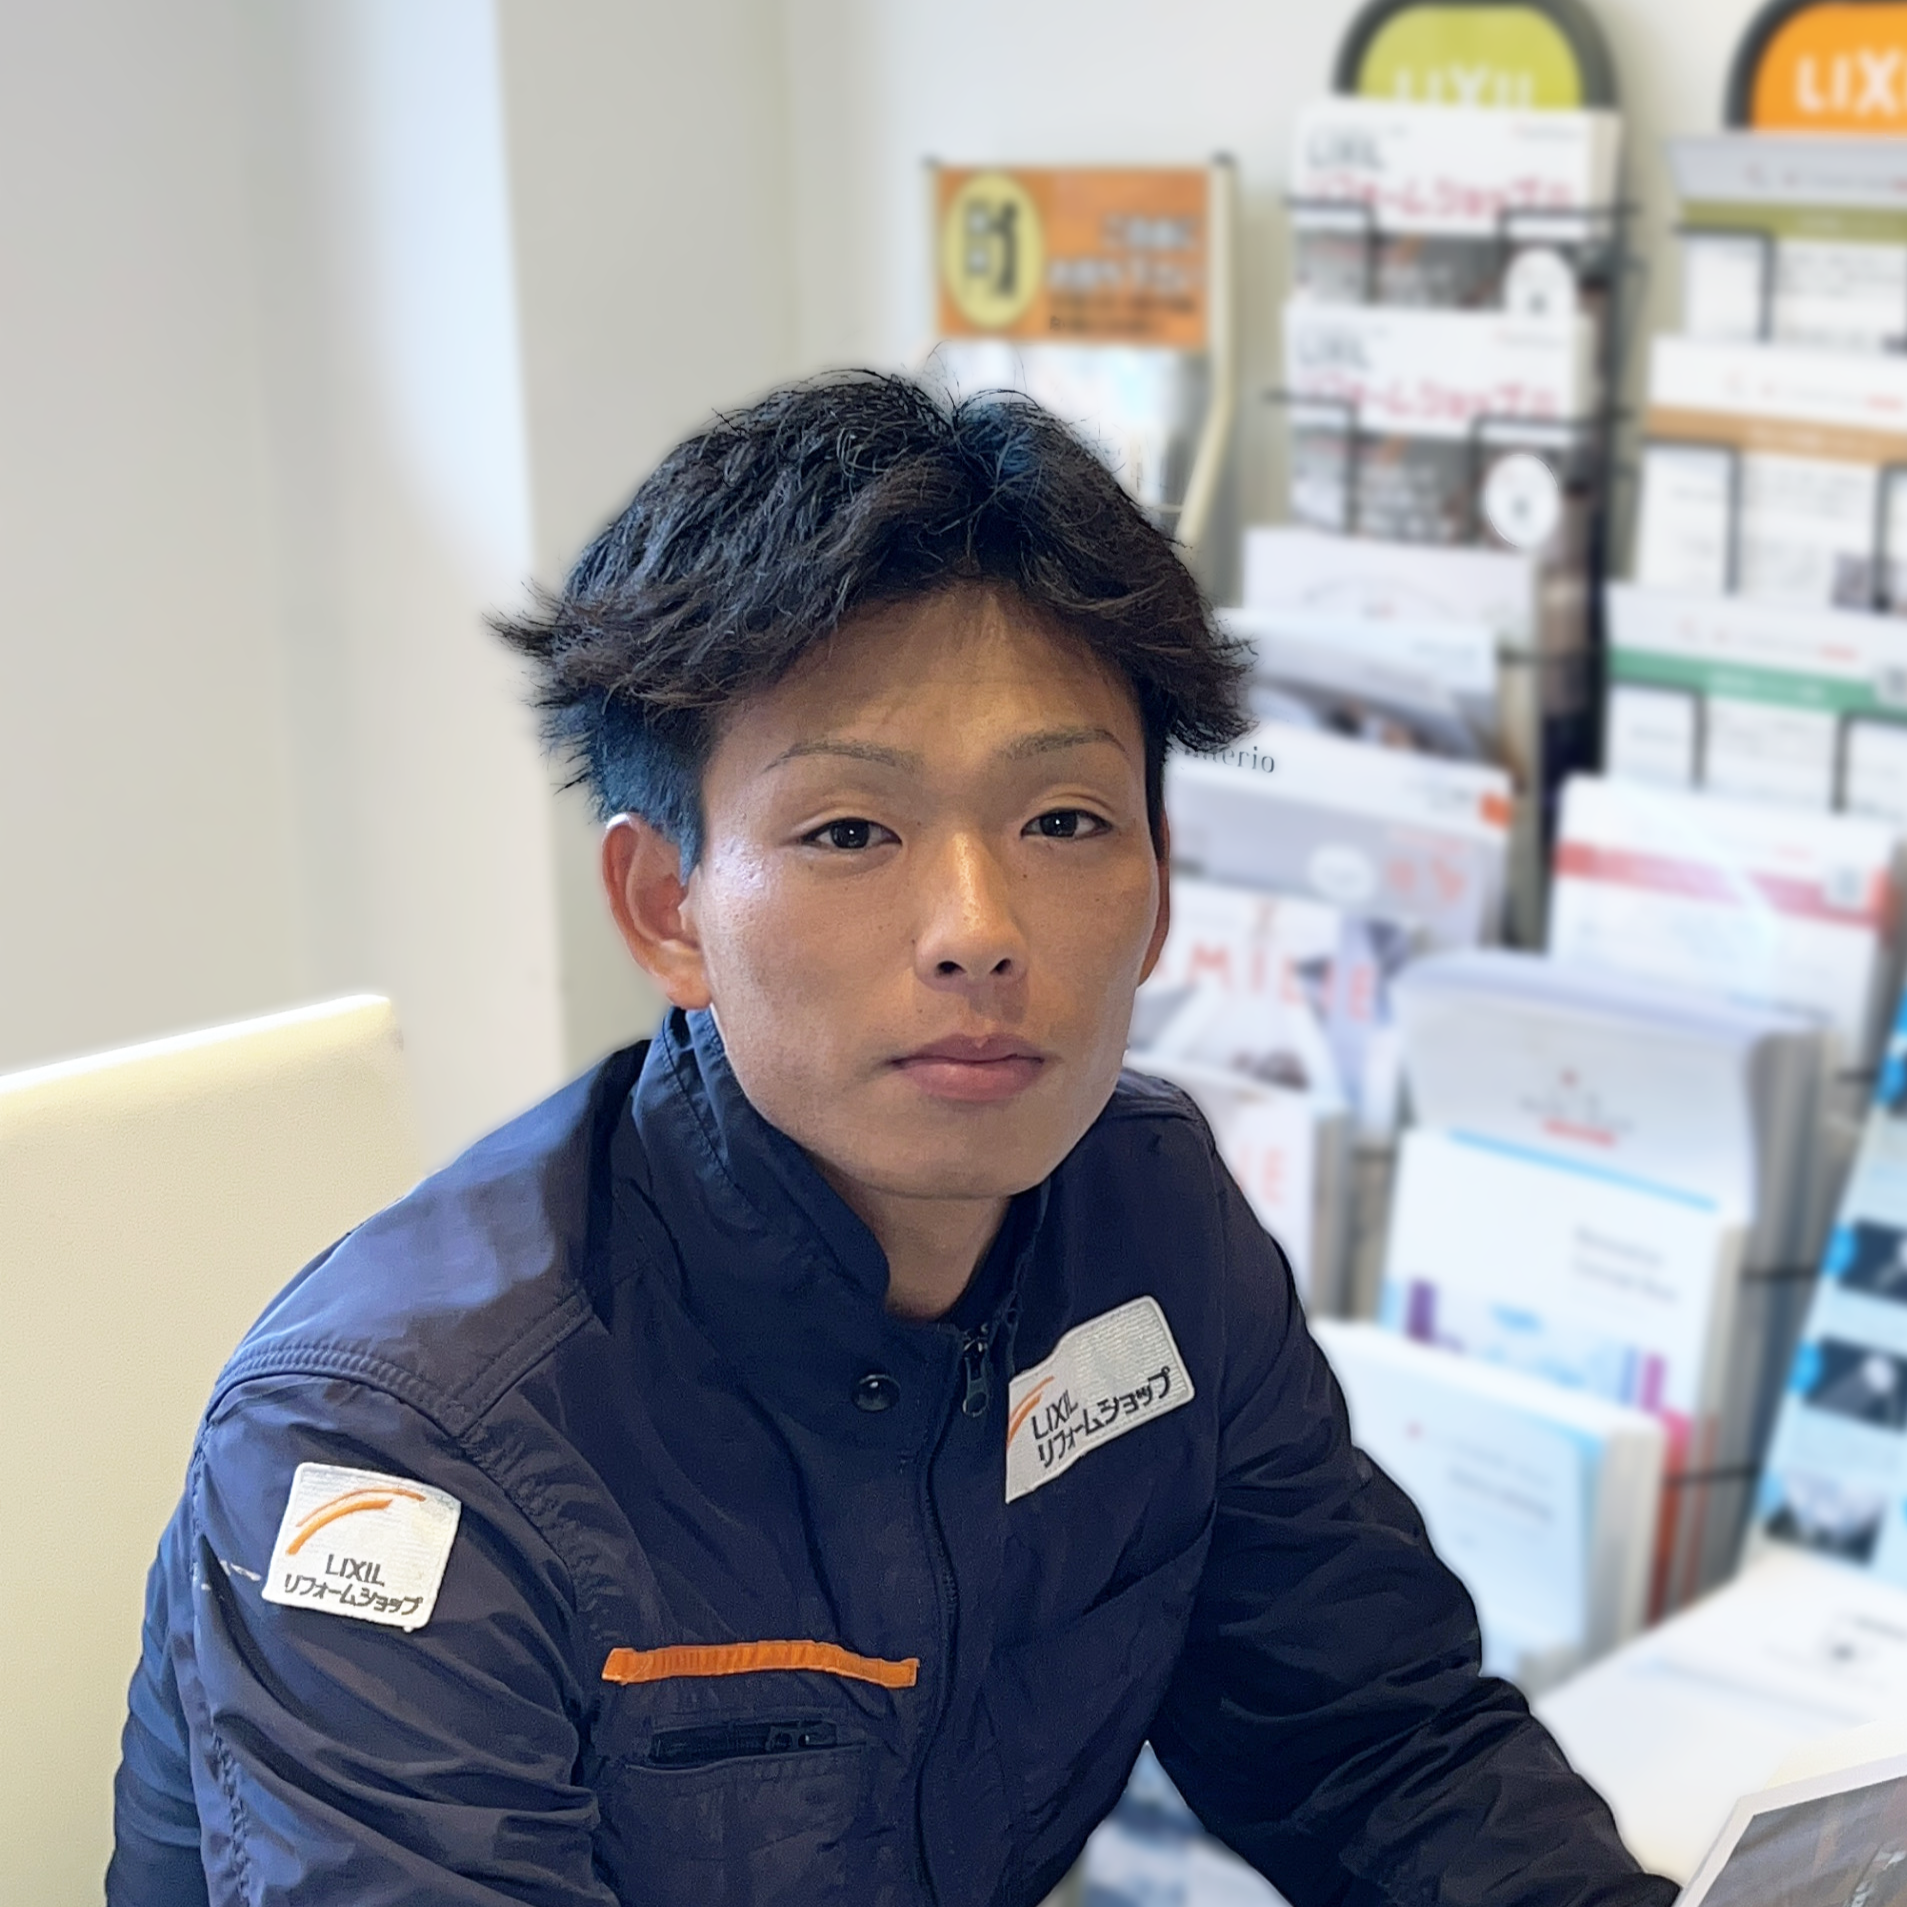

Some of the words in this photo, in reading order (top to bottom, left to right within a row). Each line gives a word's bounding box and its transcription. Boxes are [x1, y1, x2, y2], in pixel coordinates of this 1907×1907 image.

[1796, 49, 1907, 115] LIX
[1031, 1389, 1078, 1440] LIXIL
[1038, 1365, 1171, 1468] リフォームショップ
[285, 1574, 424, 1616] リフォームショップ
[325, 1553, 385, 1587] LIXIL
